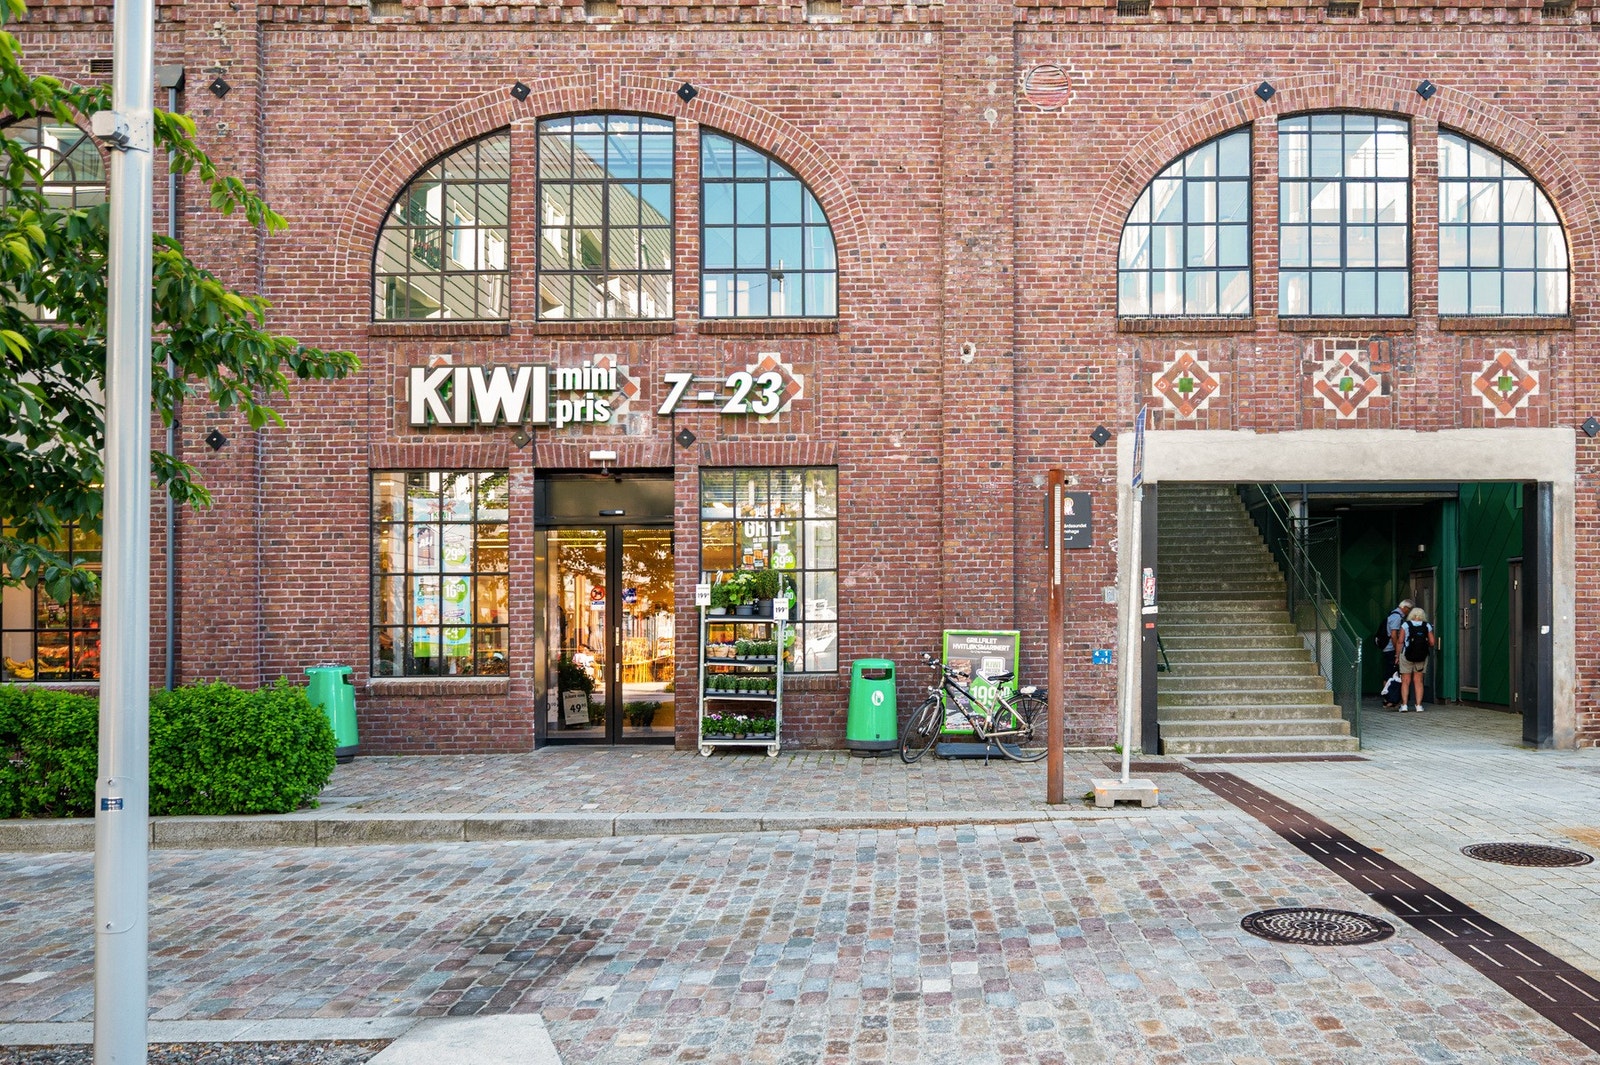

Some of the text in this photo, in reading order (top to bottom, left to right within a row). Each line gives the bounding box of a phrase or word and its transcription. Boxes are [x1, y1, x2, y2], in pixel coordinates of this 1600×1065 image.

[556, 360, 617, 390] mini
[409, 364, 550, 427] KIWI
[556, 392, 611, 428] pris
